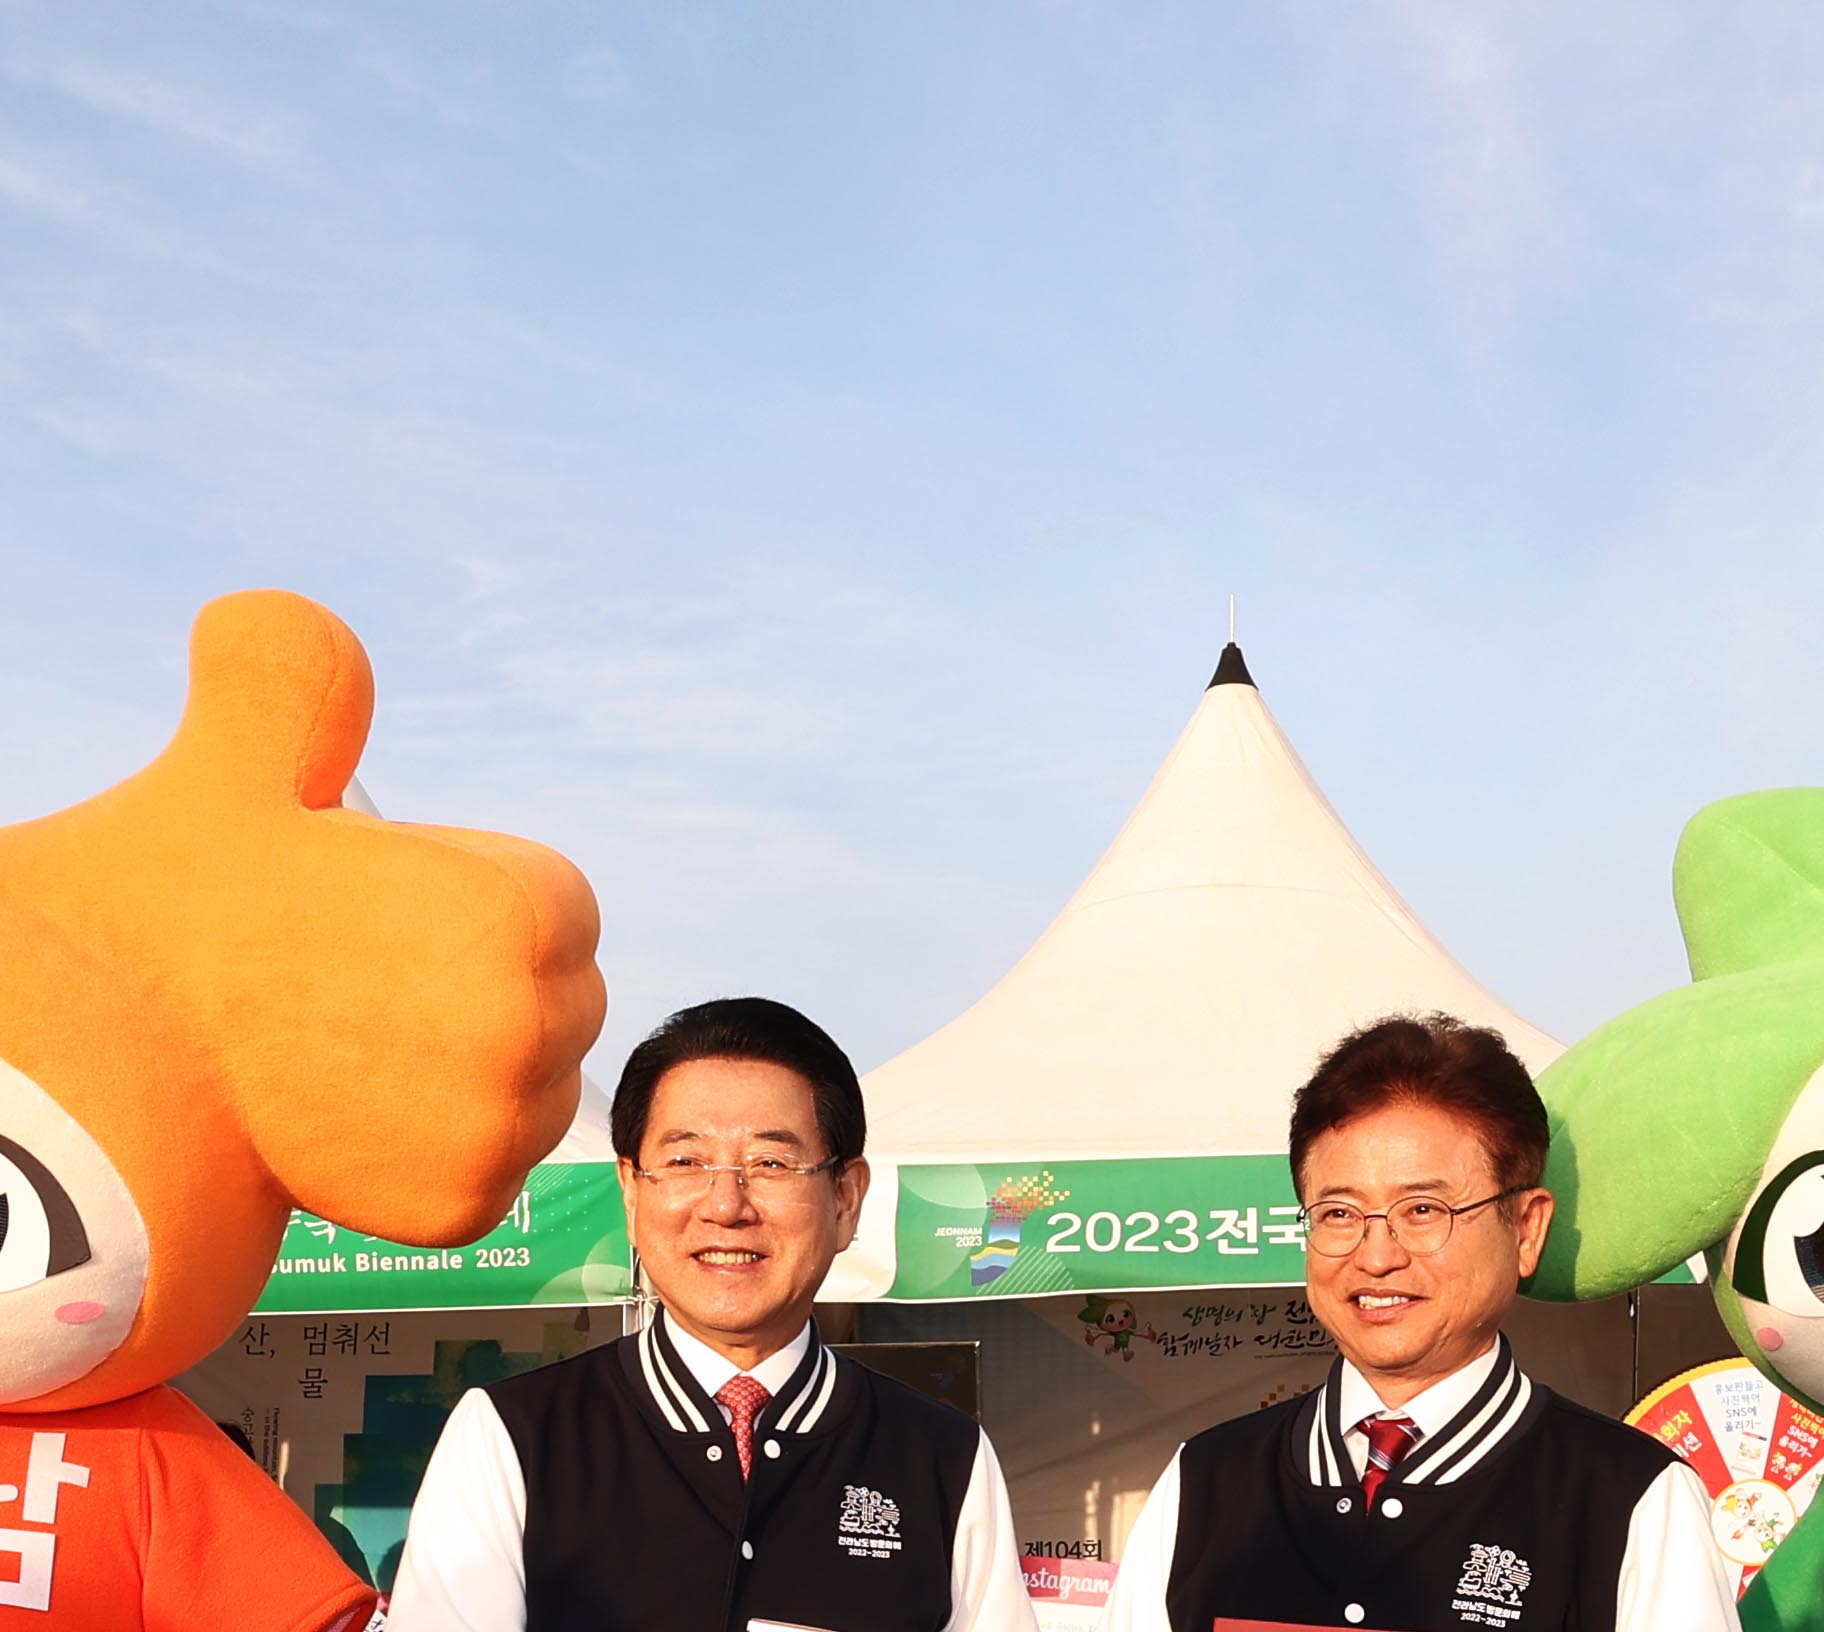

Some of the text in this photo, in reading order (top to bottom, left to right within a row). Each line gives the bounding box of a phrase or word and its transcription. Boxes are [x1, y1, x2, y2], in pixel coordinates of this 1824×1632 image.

[934, 1226, 982, 1237] JEONNAM
[956, 1236, 983, 1248] 2023
[271, 1247, 531, 1274] umuk Biennale 2023
[239, 1322, 392, 1358] 산, 멈춰선
[298, 1368, 328, 1399] 물
[1725, 1406, 1757, 1418] SNS에
[1787, 1425, 1819, 1449] SNS에
[1024, 1539, 1102, 1561] 제104회
[1022, 1567, 1110, 1600] nstagram
[1460, 1612, 1506, 1628] 2022-2023
